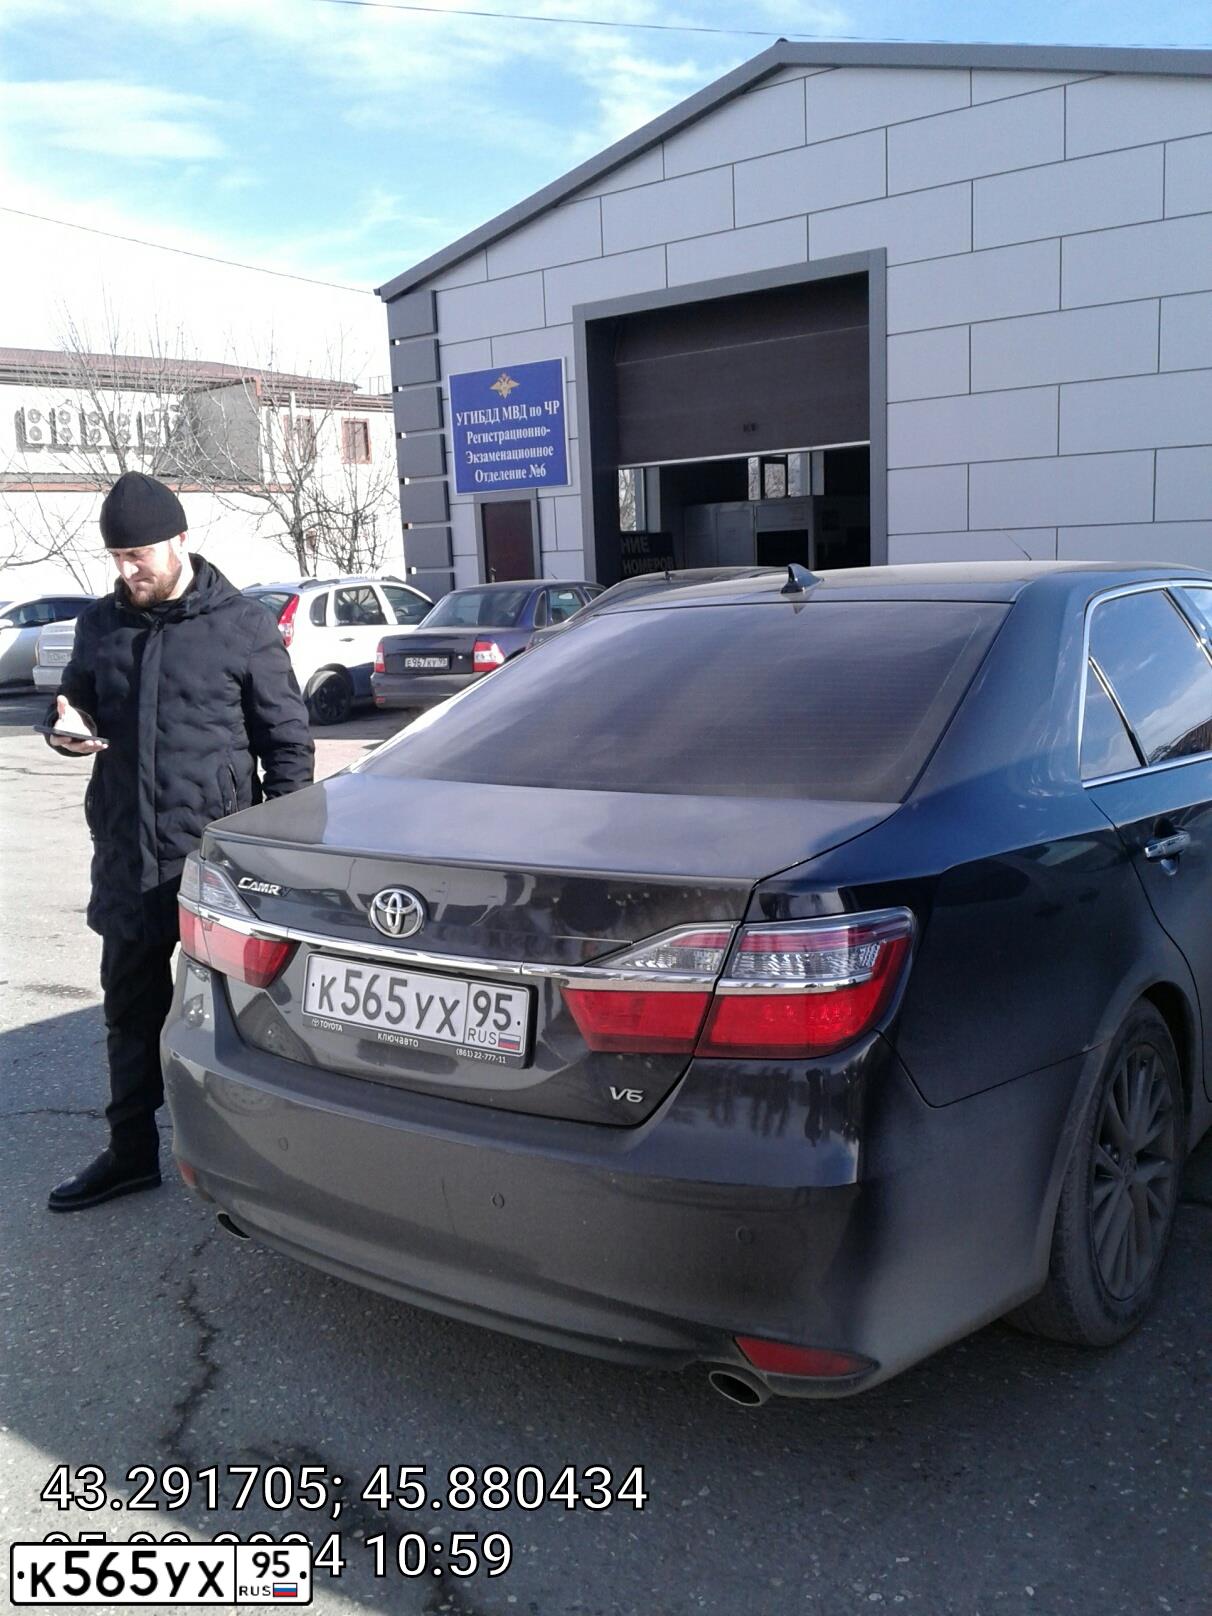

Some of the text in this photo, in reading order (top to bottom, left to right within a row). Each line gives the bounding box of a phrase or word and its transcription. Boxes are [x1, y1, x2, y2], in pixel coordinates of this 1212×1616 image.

[456, 400, 560, 426] УГИБДД МВД по ЧР
[466, 426, 551, 445] Регистрационно-
[465, 445, 554, 464] Экзаменационное
[475, 463, 546, 483] Отделение №6
[472, 990, 512, 1031] 95
[320, 1020, 343, 1032] TOYOTA
[467, 1027, 497, 1045] RUS
[609, 1086, 643, 1103] V6
